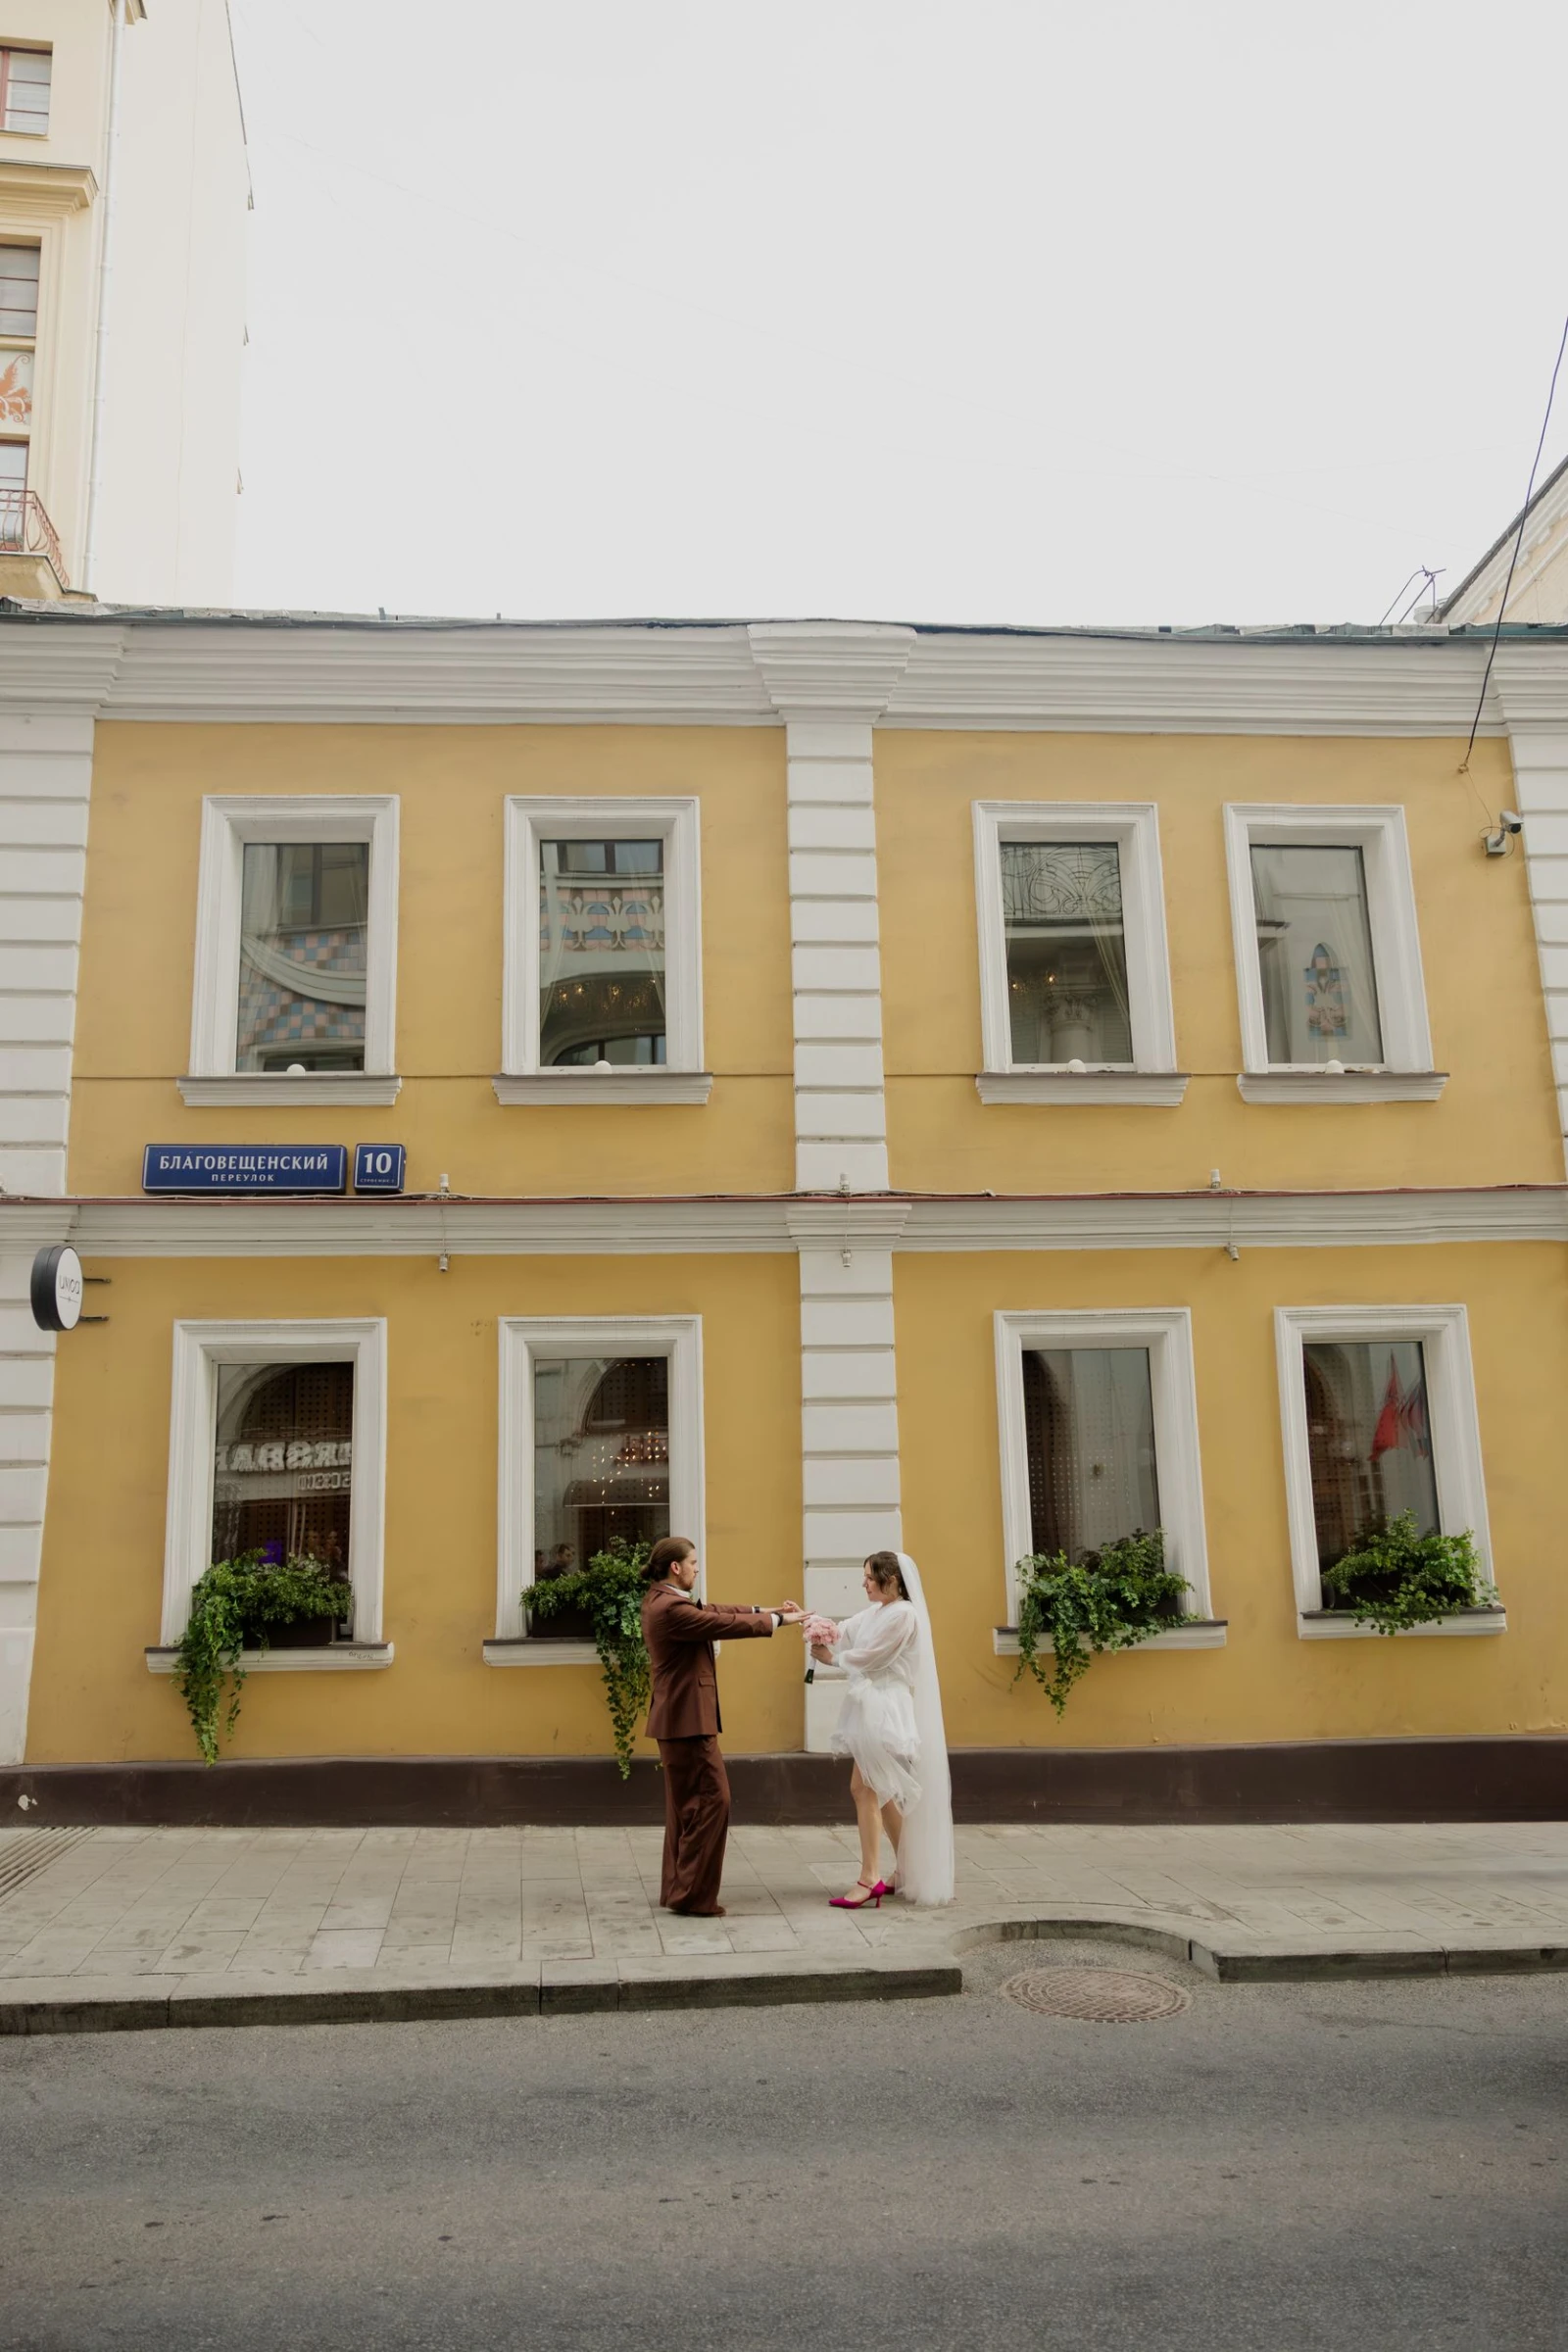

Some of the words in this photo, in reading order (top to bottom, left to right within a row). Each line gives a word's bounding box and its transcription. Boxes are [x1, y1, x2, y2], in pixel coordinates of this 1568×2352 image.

[159, 1152, 328, 1171] БЛАГОВЕЩЕНСКИЙ
[364, 1152, 392, 1174] 10
[212, 1173, 274, 1182] ПЕРЕУЛОК
